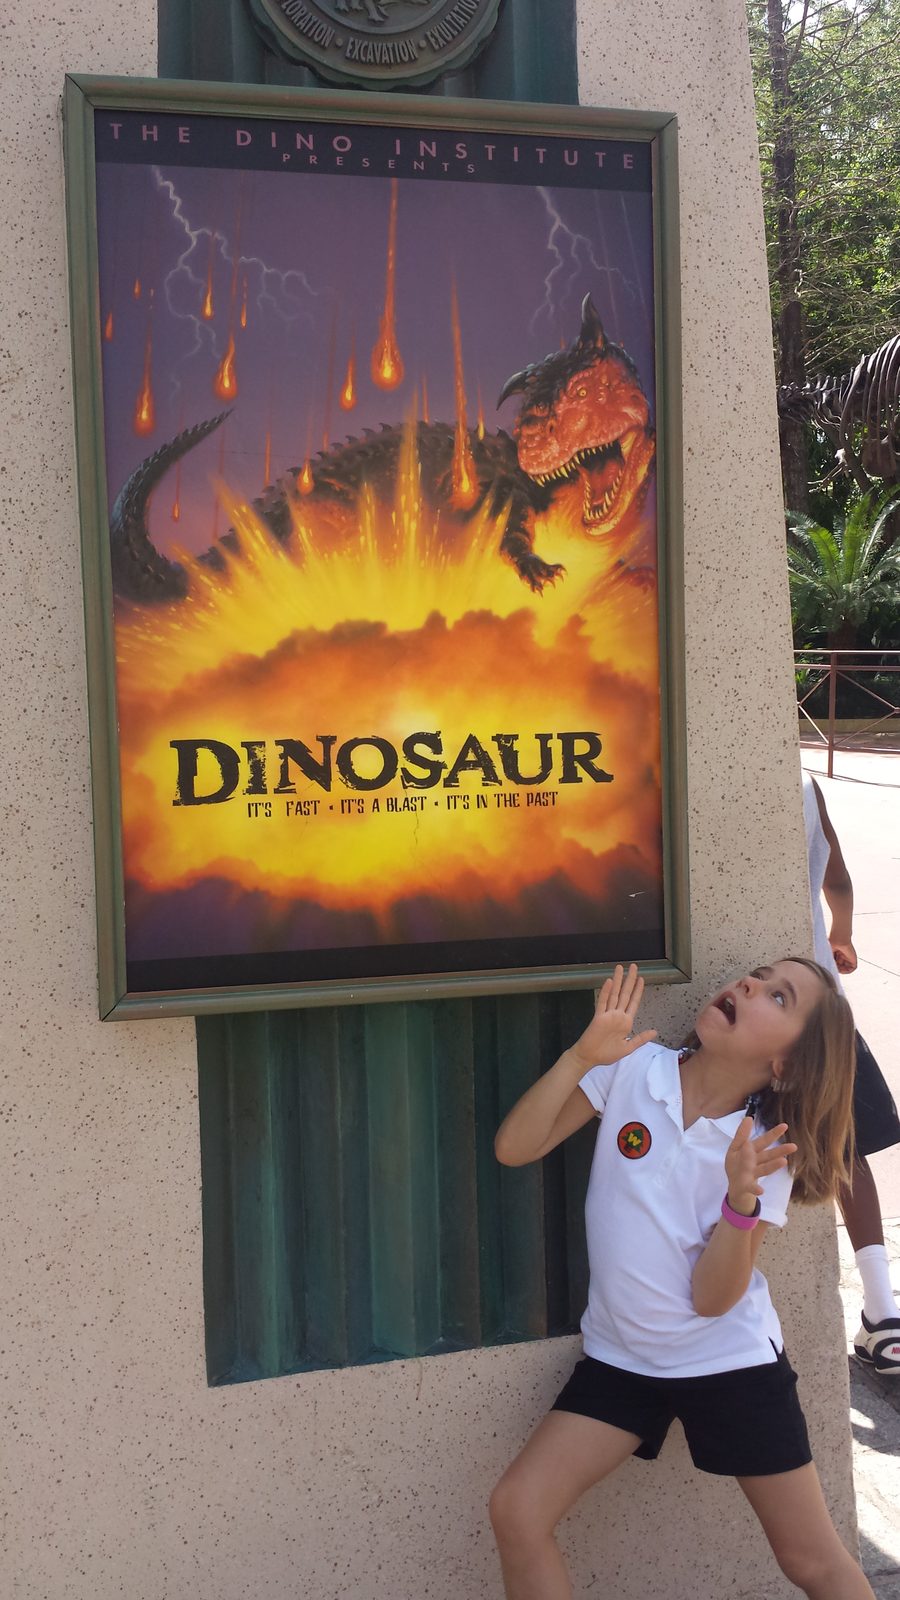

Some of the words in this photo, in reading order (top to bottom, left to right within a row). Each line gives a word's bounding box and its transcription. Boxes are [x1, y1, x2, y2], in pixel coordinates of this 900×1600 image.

[345, 37, 418, 64] EXCAVATION
[426, 0, 480, 50] EXULTATIO
[110, 123, 190, 143] THE
[236, 130, 352, 152] DINO
[395, 139, 634, 169] INSTITUTE
[282, 153, 475, 174] PRESENTS
[169, 730, 614, 807] DINOSAUR
[247, 801, 272, 818] IT'S
[286, 800, 320, 817] FAST
[341, 798, 364, 814] IT'S
[372, 799, 380, 813] A
[386, 796, 427, 813] BLAST
[447, 794, 470, 810] IT'S
[477, 794, 488, 809] IN
[494, 792, 520, 808] THE
[526, 791, 558, 808] PAST
